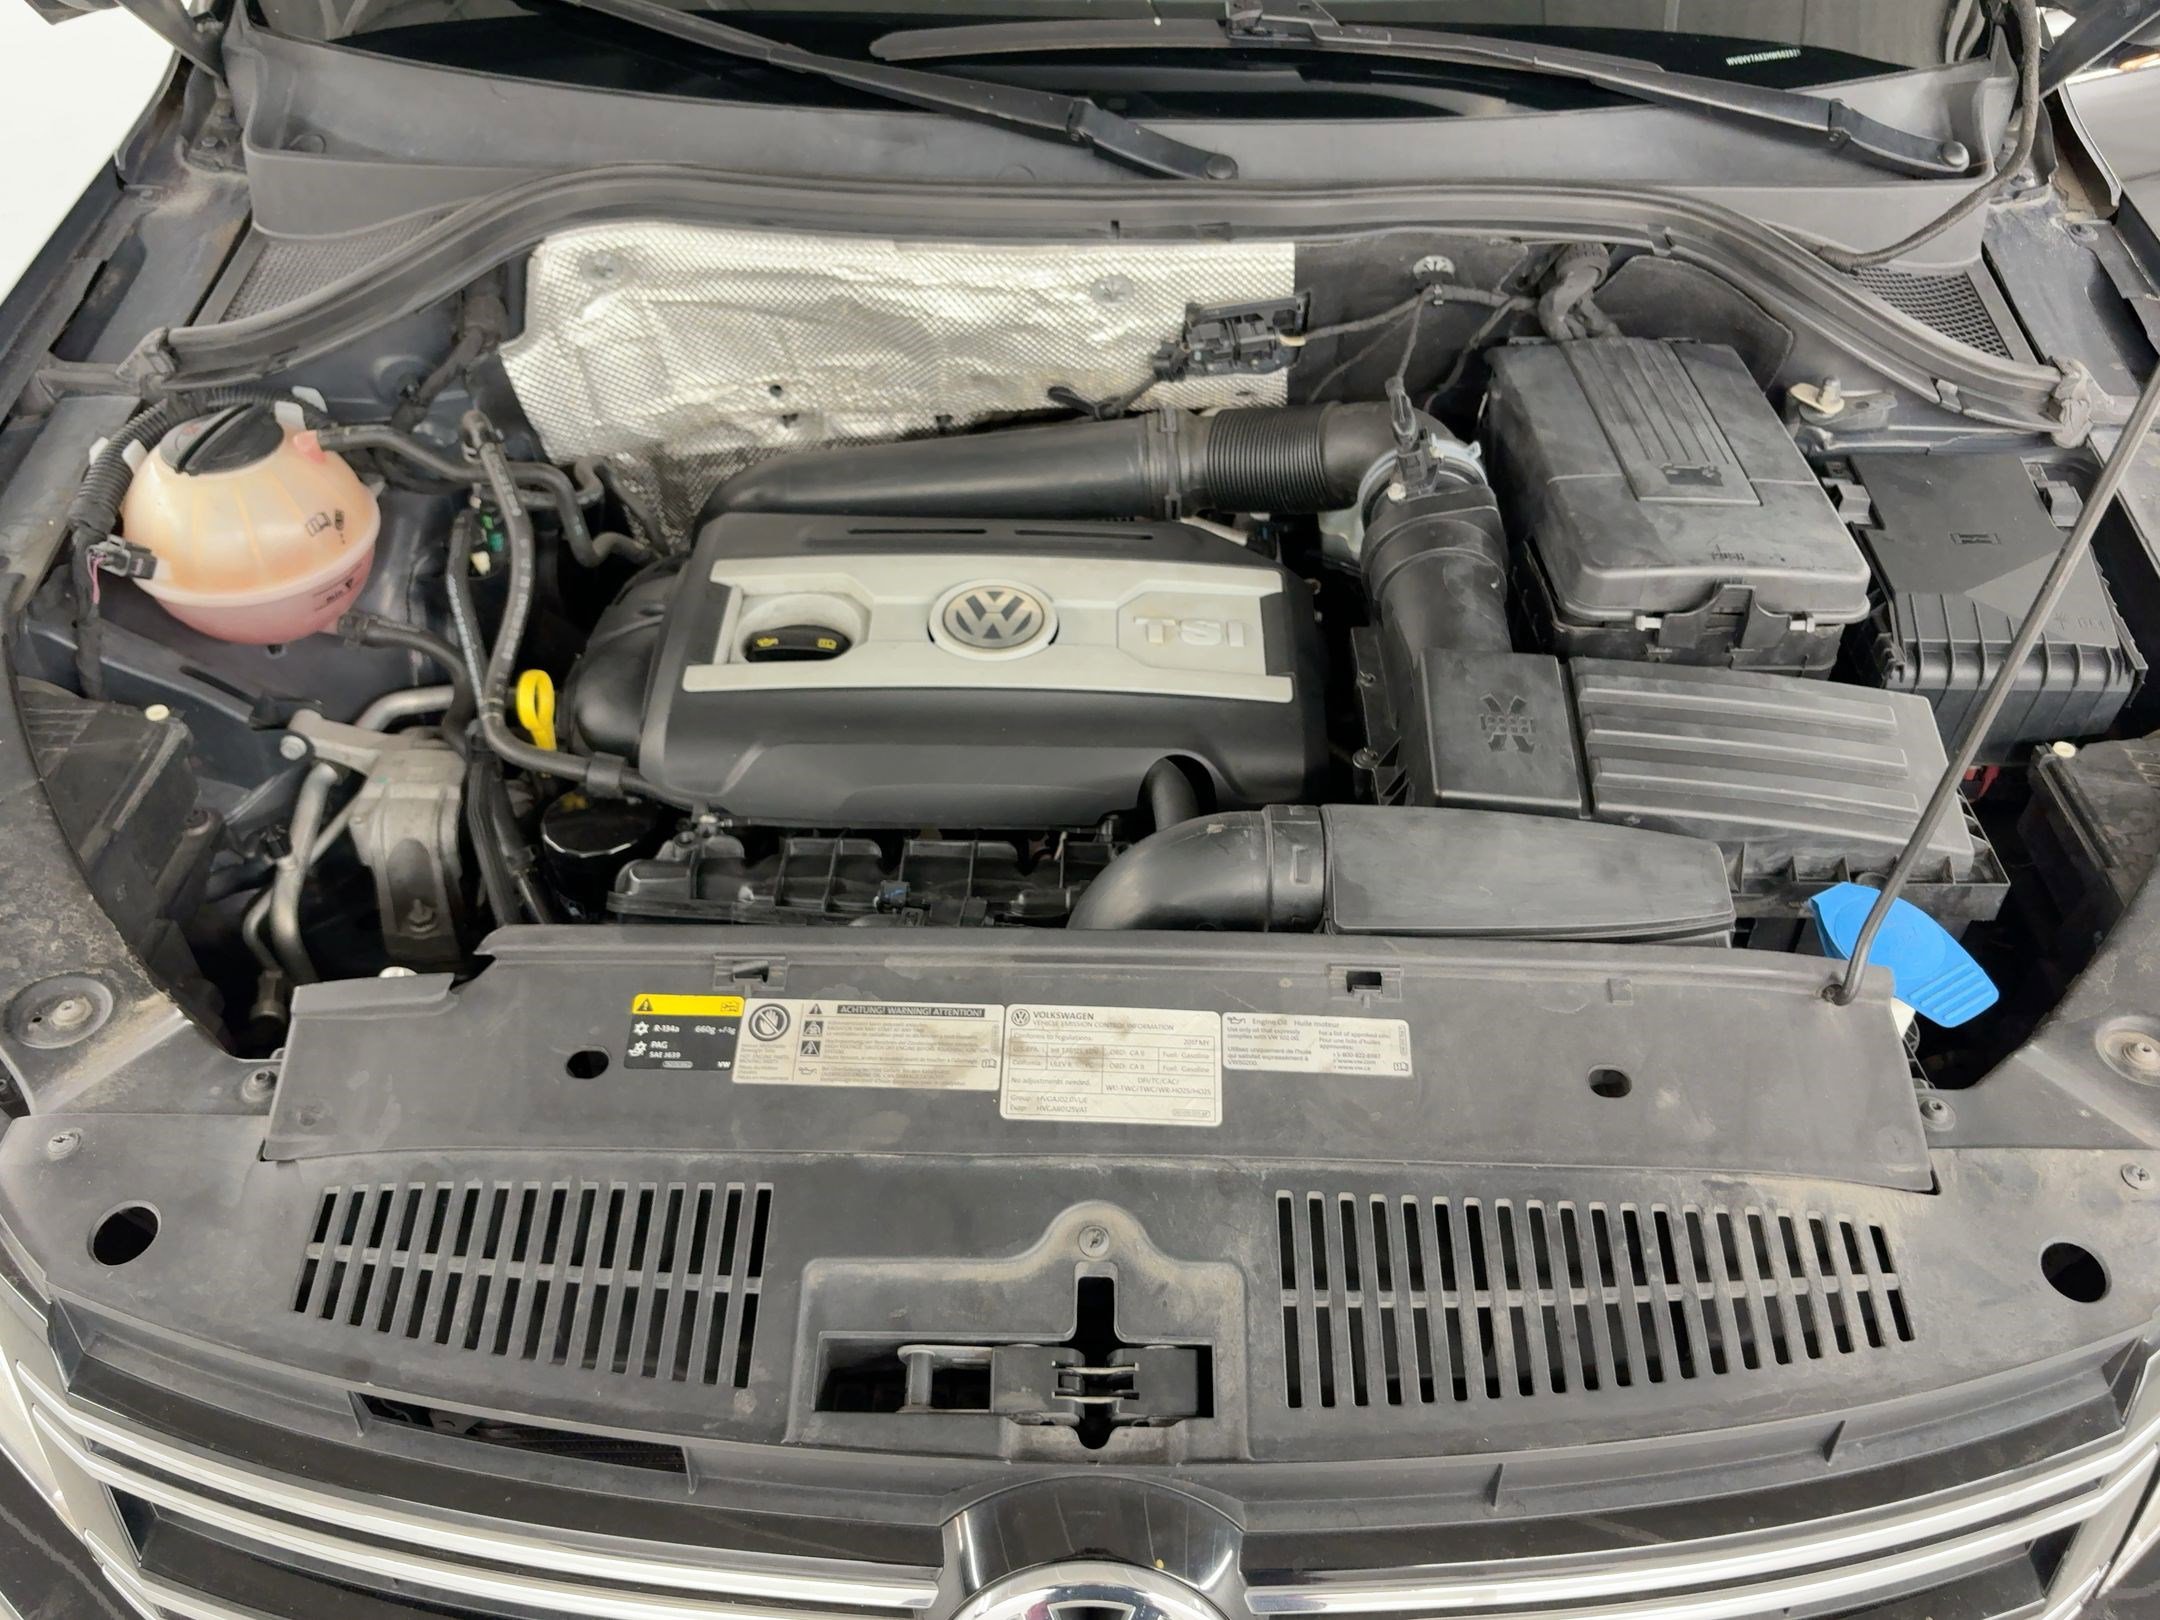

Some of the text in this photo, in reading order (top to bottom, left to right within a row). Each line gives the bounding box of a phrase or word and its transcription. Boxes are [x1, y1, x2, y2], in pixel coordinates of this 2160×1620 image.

[1133, 616, 1246, 647] TSI
[840, 1006, 982, 1017] ACHTUNG! WARNING! ATTENTION!
[1033, 1011, 1095, 1020] VOLKSWAGEN
[1127, 1022, 1175, 1030] INFORMATION
[1252, 1018, 1288, 1026] Engine Oil
[653, 1024, 680, 1033] R-134a
[694, 1025, 716, 1035] 660g
[650, 1041, 668, 1049] PAG
